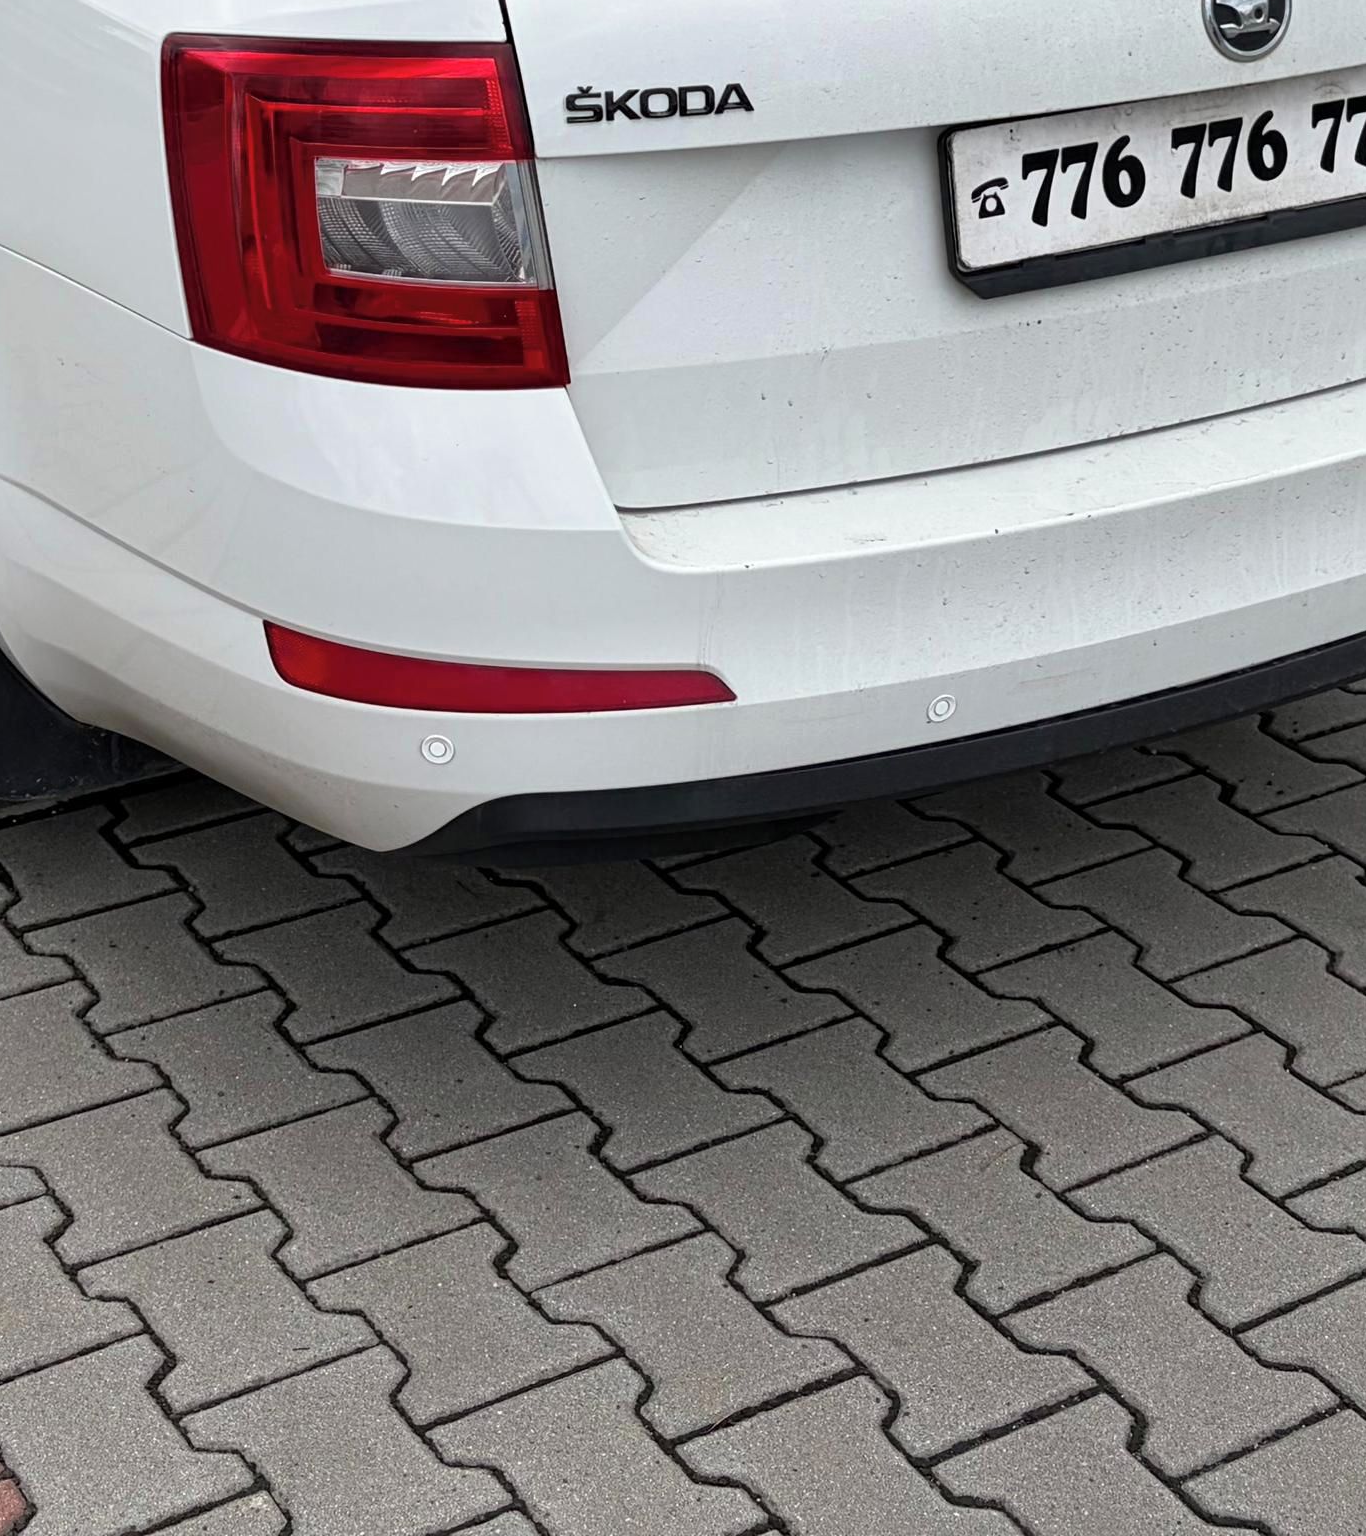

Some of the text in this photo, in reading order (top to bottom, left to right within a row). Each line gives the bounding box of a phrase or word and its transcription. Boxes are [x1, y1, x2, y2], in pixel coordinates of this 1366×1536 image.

[565, 82, 755, 124] ŠKODA
[1021, 134, 1147, 227] 776
[1170, 109, 1289, 200] 776
